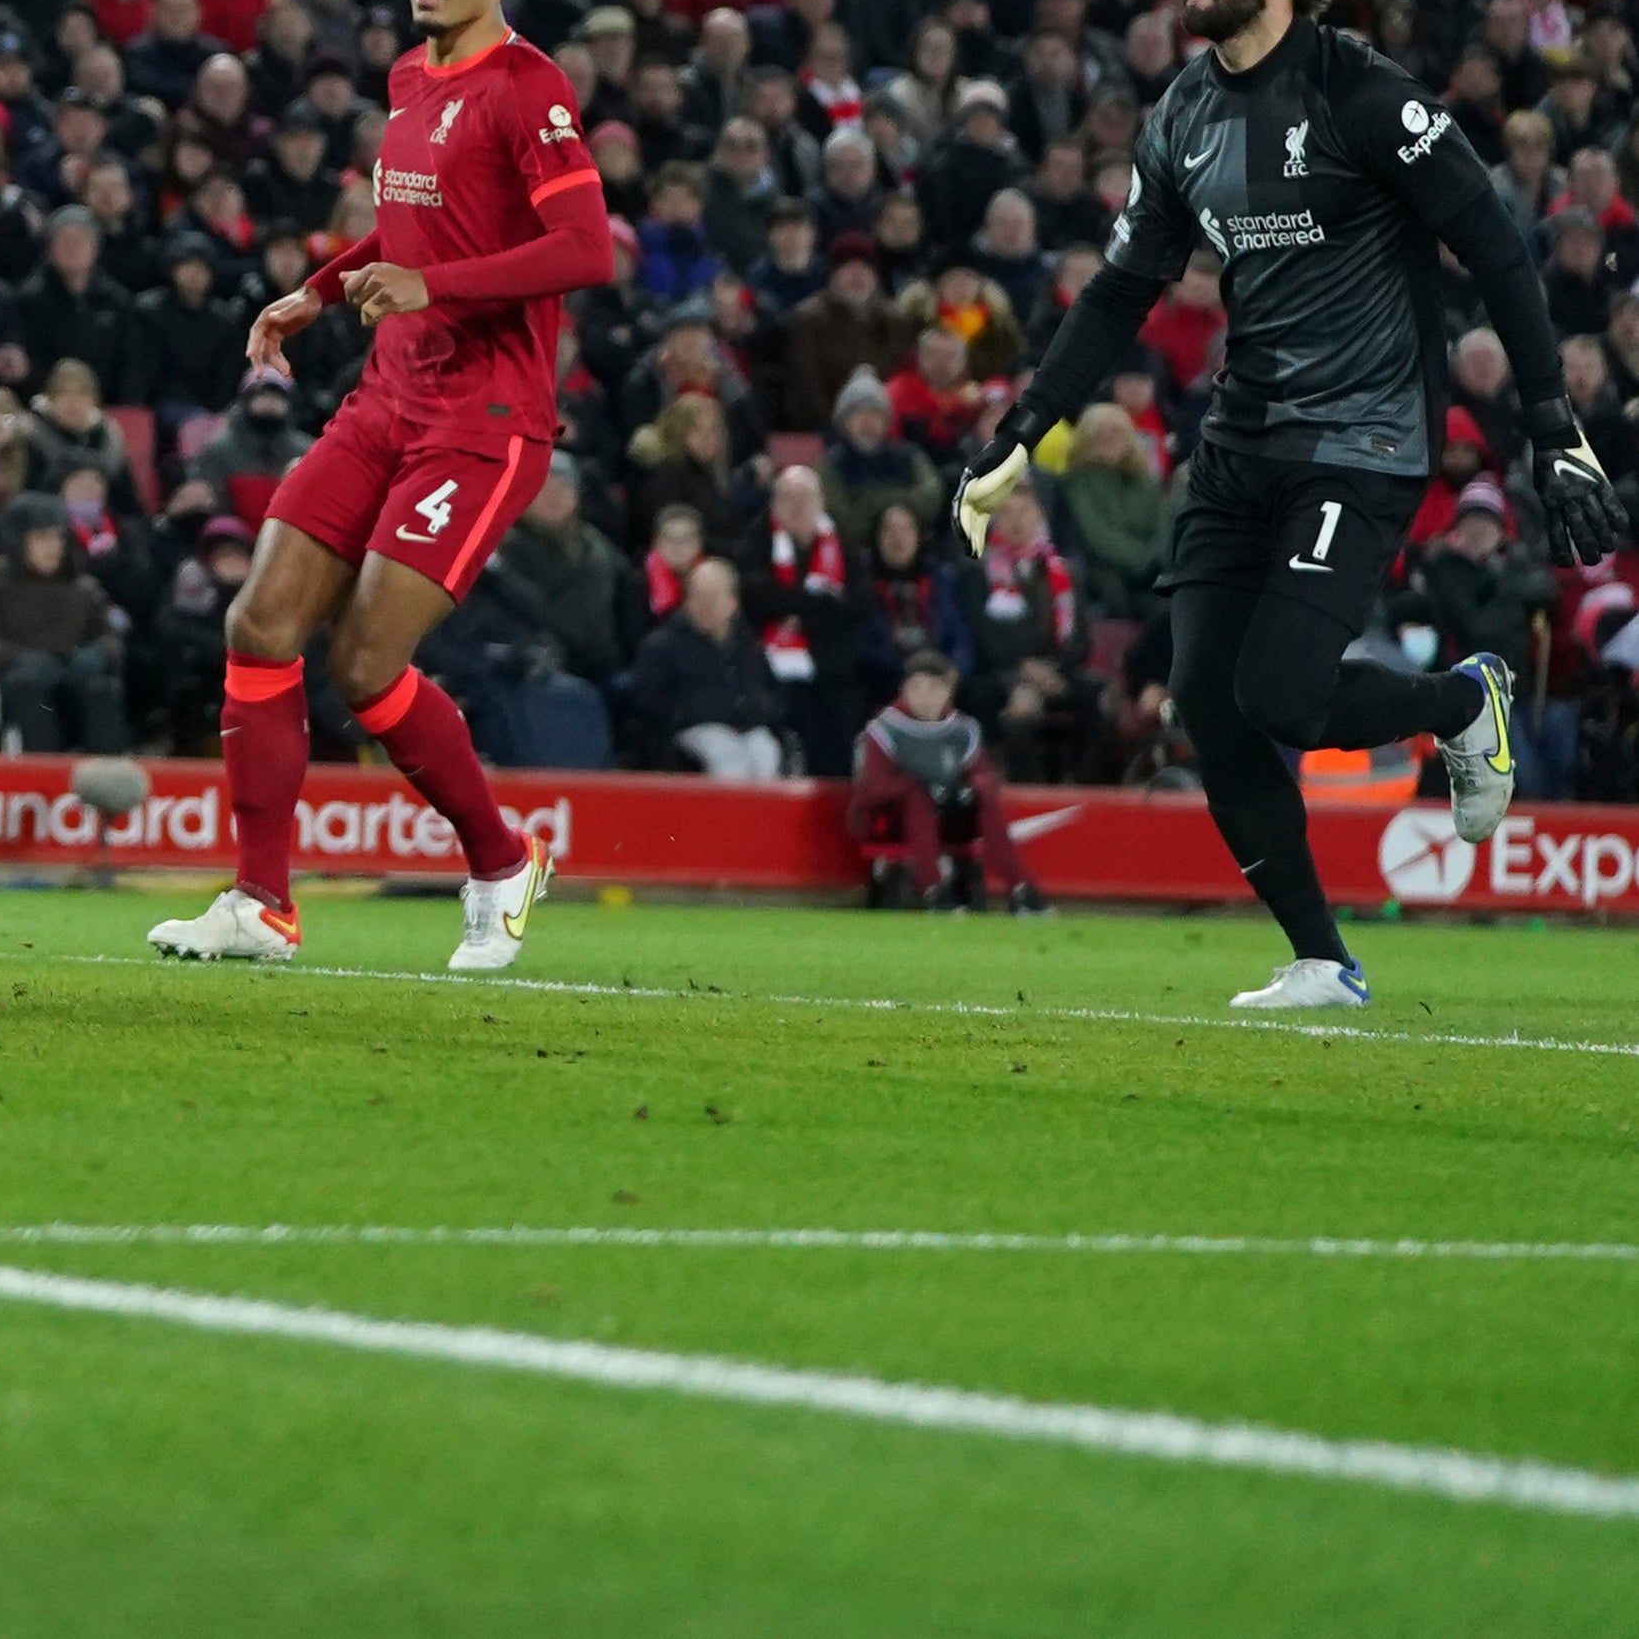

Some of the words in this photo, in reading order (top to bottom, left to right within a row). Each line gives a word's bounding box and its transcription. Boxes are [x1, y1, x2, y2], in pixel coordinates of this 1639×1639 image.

[1397, 111, 1452, 165] Expedia
[382, 185, 442, 207] chartered
[384, 167, 437, 190] standard
[1226, 209, 1314, 233] standard
[1233, 225, 1325, 251] chartered
[414, 478, 459, 535] 4
[1312, 500, 1342, 560] 1
[1489, 815, 1639, 908] Exp
